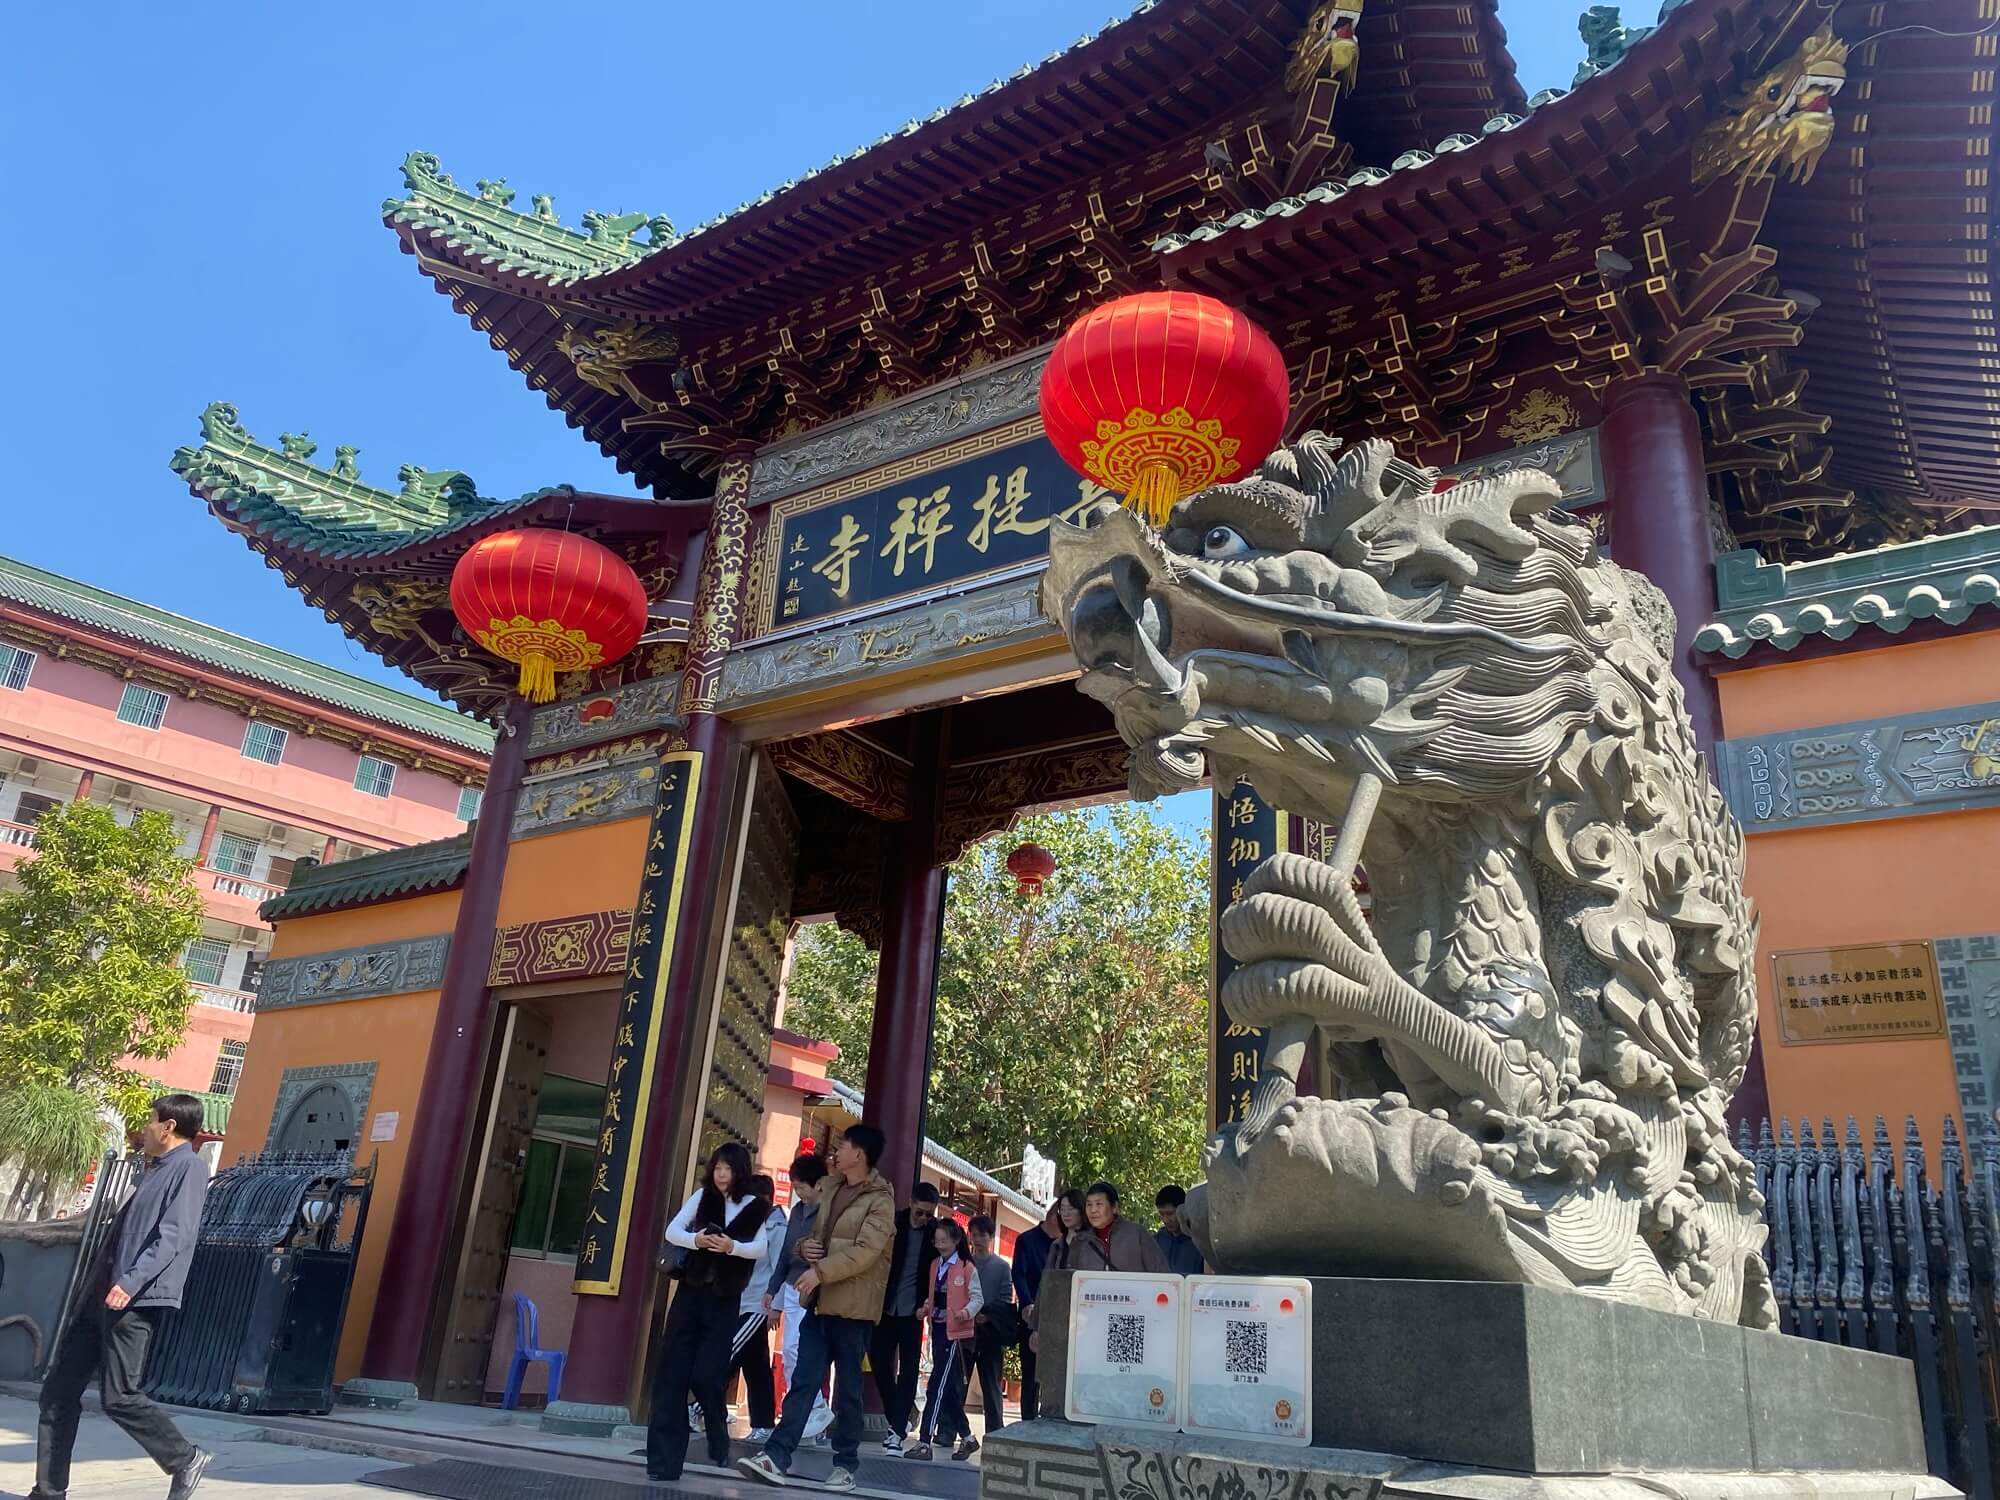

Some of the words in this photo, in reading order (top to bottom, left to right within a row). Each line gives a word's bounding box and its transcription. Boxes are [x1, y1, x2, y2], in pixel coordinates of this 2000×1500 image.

[1786, 967, 1923, 987] 禁止未成年人参加宗教活动
[1790, 989, 1928, 1009] 禁止向未成年人进行传教活动
